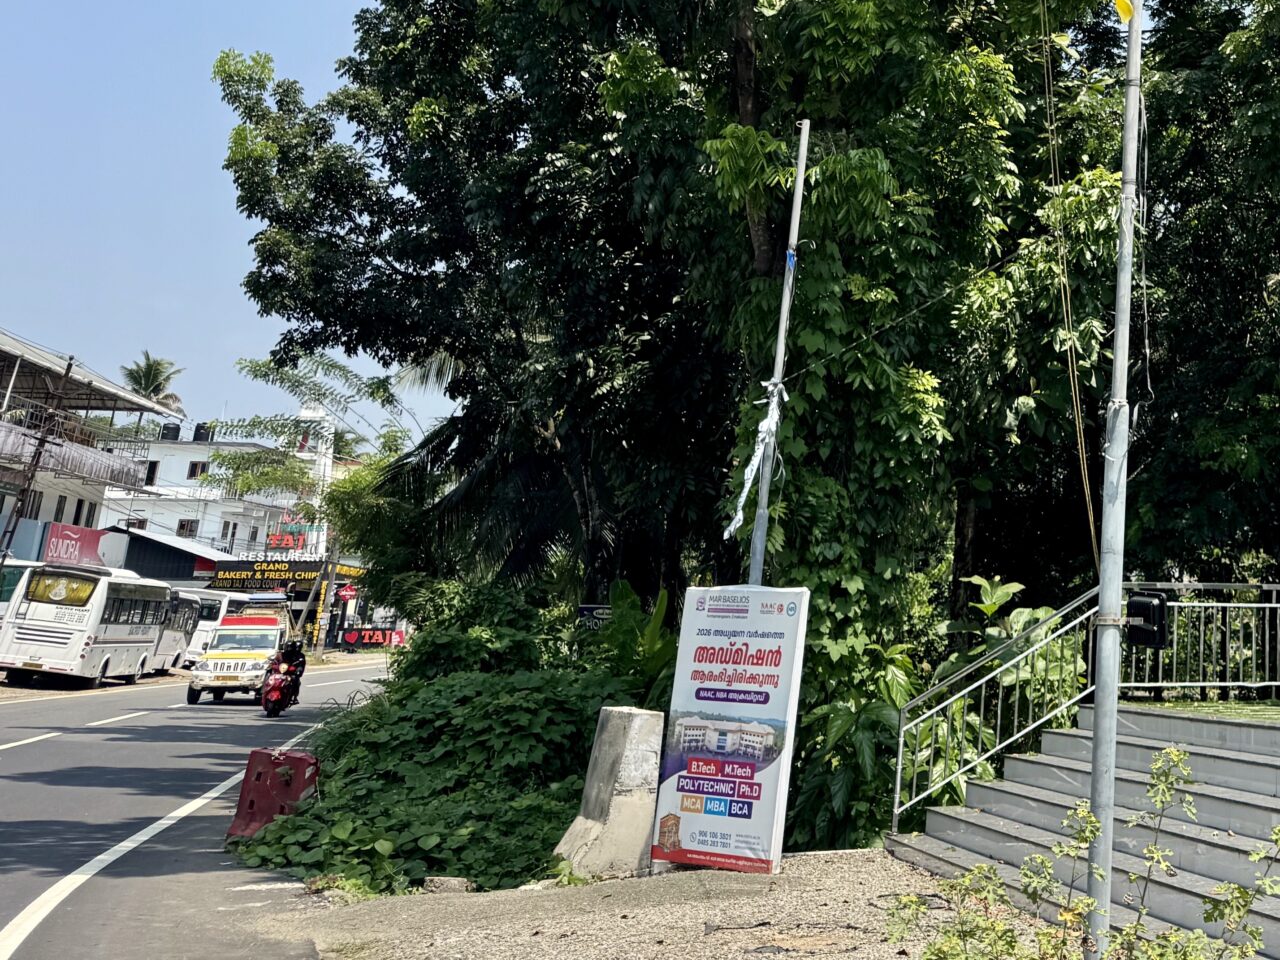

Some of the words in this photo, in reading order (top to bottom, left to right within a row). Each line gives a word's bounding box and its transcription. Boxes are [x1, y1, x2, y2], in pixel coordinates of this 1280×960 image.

[267, 533, 306, 550] TAJ
[254, 563, 289, 571] GRAND
[217, 571, 252, 579] BAKERY
[254, 571, 262, 579] &
[211, 579, 232, 588] GRAND
[244, 580, 260, 588] FOOD
[709, 595, 722, 603] MAR
[723, 596, 750, 604] BASELIOS
[362, 630, 392, 645] TAJ
[696, 628, 711, 637] 2026
[693, 641, 782, 667] അഡ്മിഷൻ
[691, 668, 779, 688] ആരംഭിച്ചിരിക്കുന്നു
[724, 764, 751, 777] M.Tech
[678, 778, 734, 794] POLYTECHNIC
[740, 784, 759, 797] Ph.D
[682, 797, 701, 809] MCA
[706, 800, 725, 812] MBA
[731, 803, 749, 815] BCA
[709, 831, 718, 839] 106
